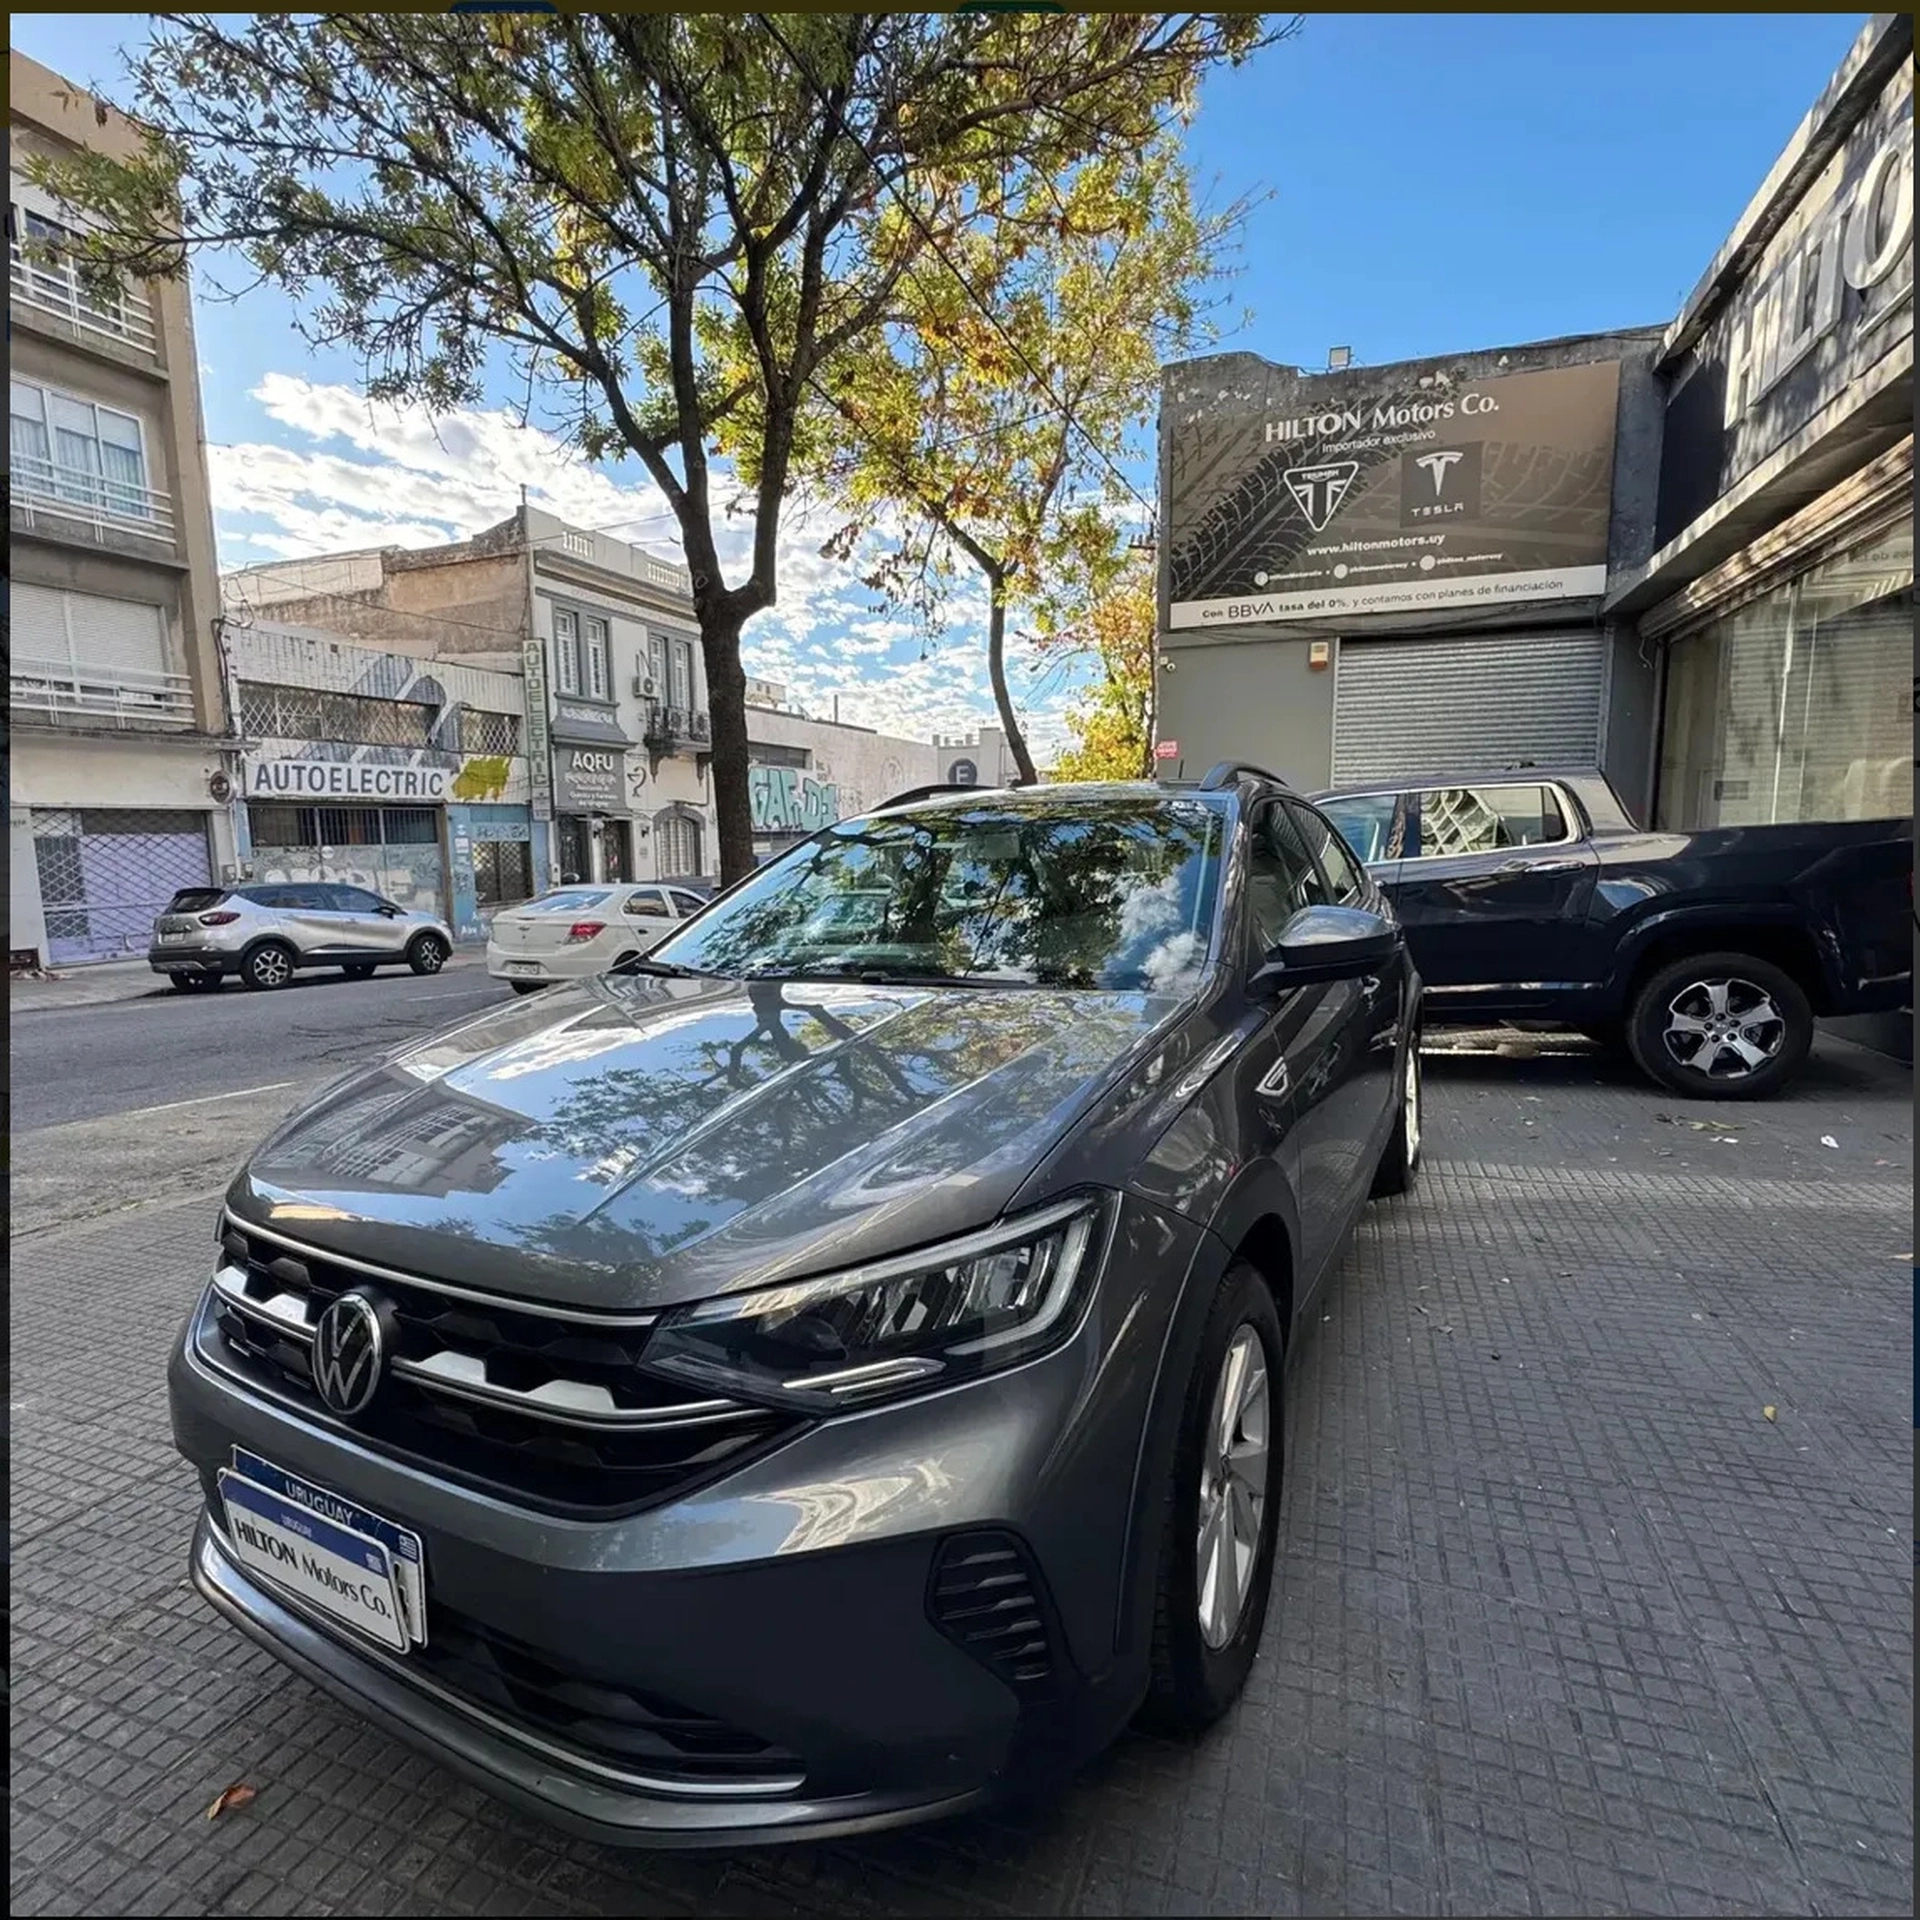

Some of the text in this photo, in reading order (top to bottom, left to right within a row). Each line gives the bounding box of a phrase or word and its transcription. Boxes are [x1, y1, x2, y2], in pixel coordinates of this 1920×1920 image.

[1265, 393, 1500, 442] HILTON Motors Co.
[1322, 429, 1436, 453] Importador exclusivo
[1411, 502, 1464, 517] TESLA
[1306, 532, 1446, 557] www.hiltonmotors.uy
[1202, 609, 1223, 619] Con
[1228, 602, 1274, 619] BBVA
[1279, 603, 1304, 613] tasa
[1307, 600, 1325, 609] del
[1361, 592, 1413, 604] contamos
[1415, 590, 1437, 600] con
[1437, 587, 1475, 600] planes
[1477, 585, 1491, 595] de
[1493, 580, 1563, 594] financiación
[525, 642, 547, 785] AUTOELECTRIC
[254, 762, 444, 797] AUTOELECTRIC
[571, 750, 614, 773] AQFU
[285, 1479, 353, 1526] URUGUAY
[234, 1517, 299, 1570] HILTON
[301, 1552, 359, 1603] Motors
[360, 1584, 393, 1620] Co.
